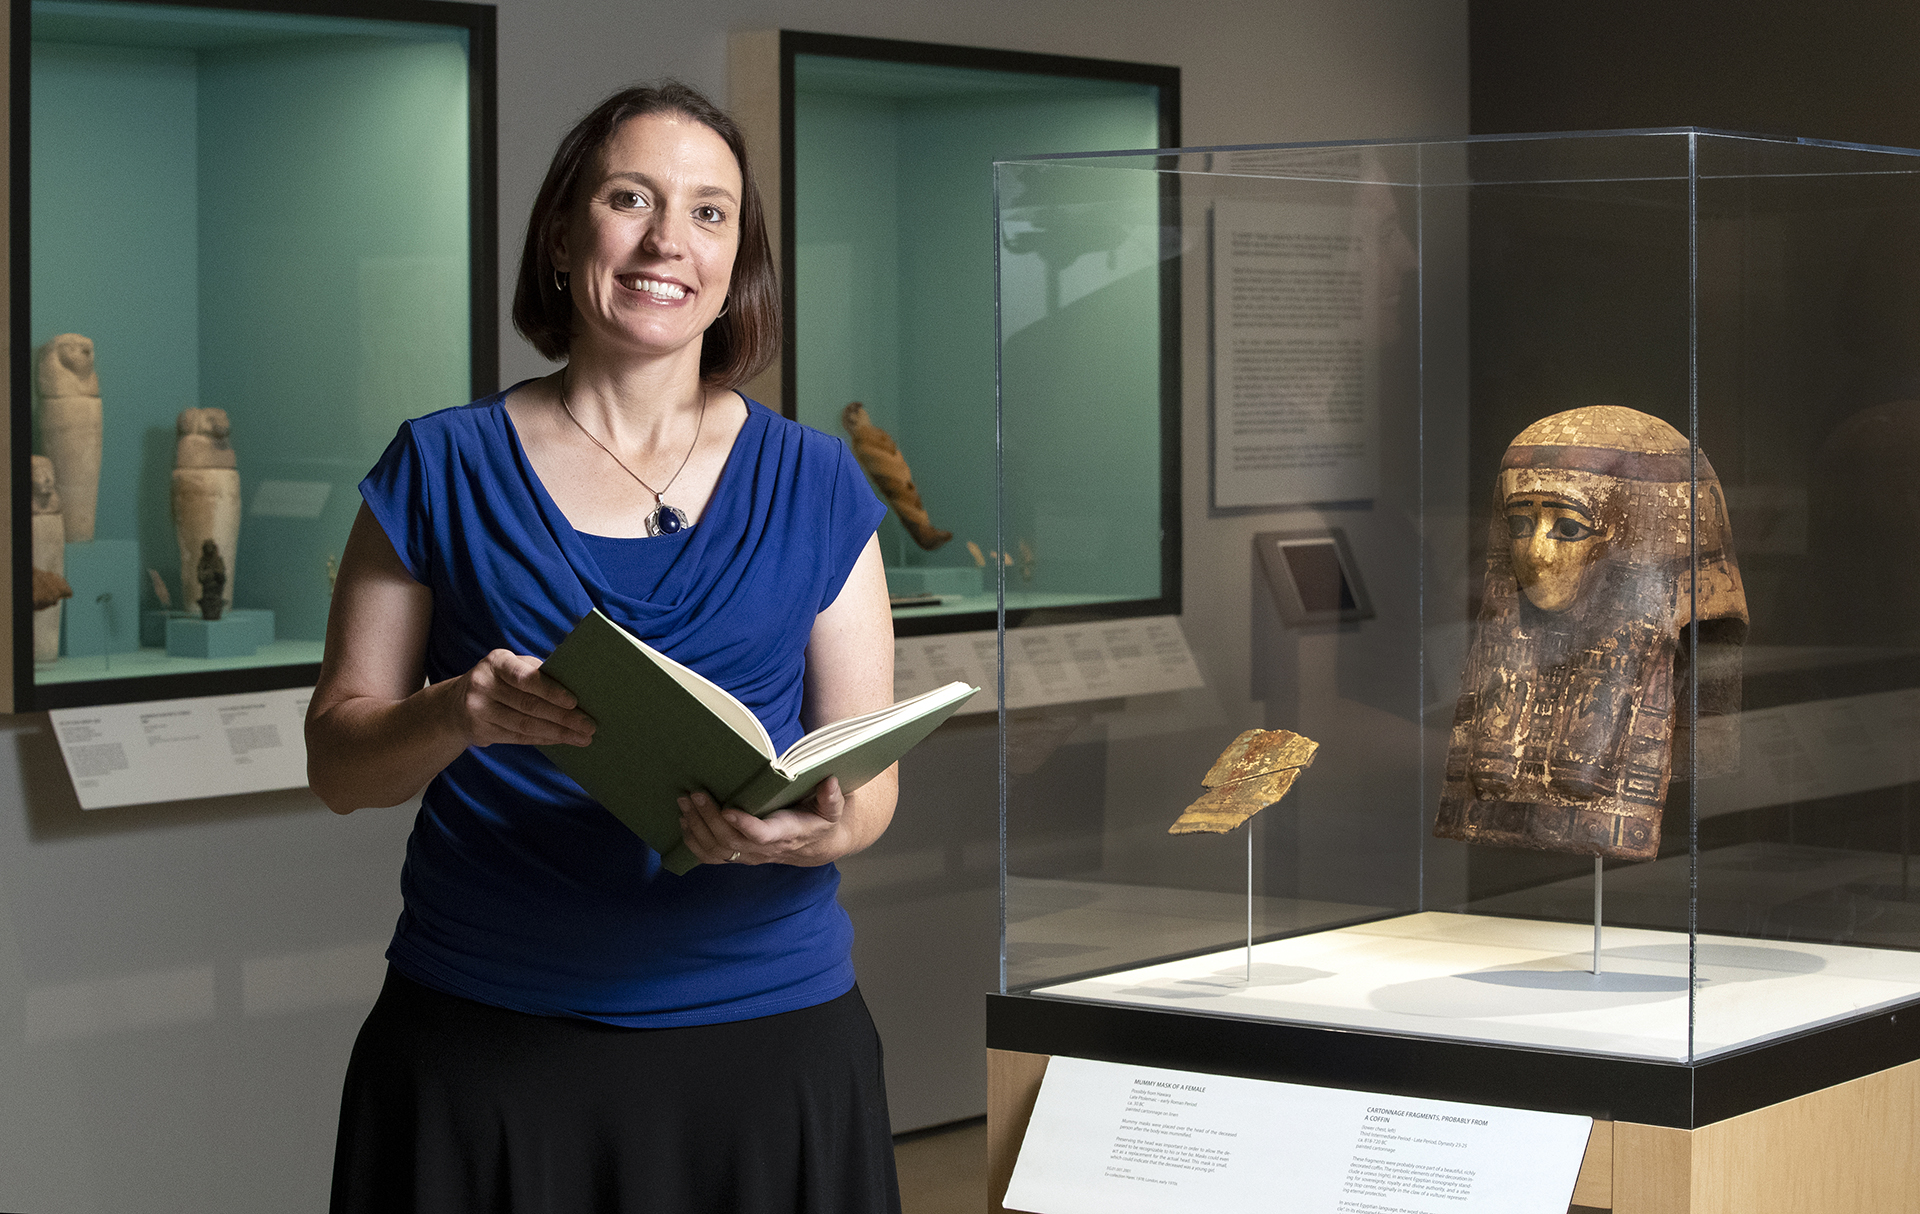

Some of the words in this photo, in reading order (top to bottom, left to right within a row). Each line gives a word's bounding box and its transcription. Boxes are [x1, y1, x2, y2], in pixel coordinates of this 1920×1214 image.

[1367, 1107, 1405, 1116] CARTONNAGE
[1405, 1111, 1440, 1121] FRAGMENTS,
[1441, 1116, 1471, 1124] PROBABLY
